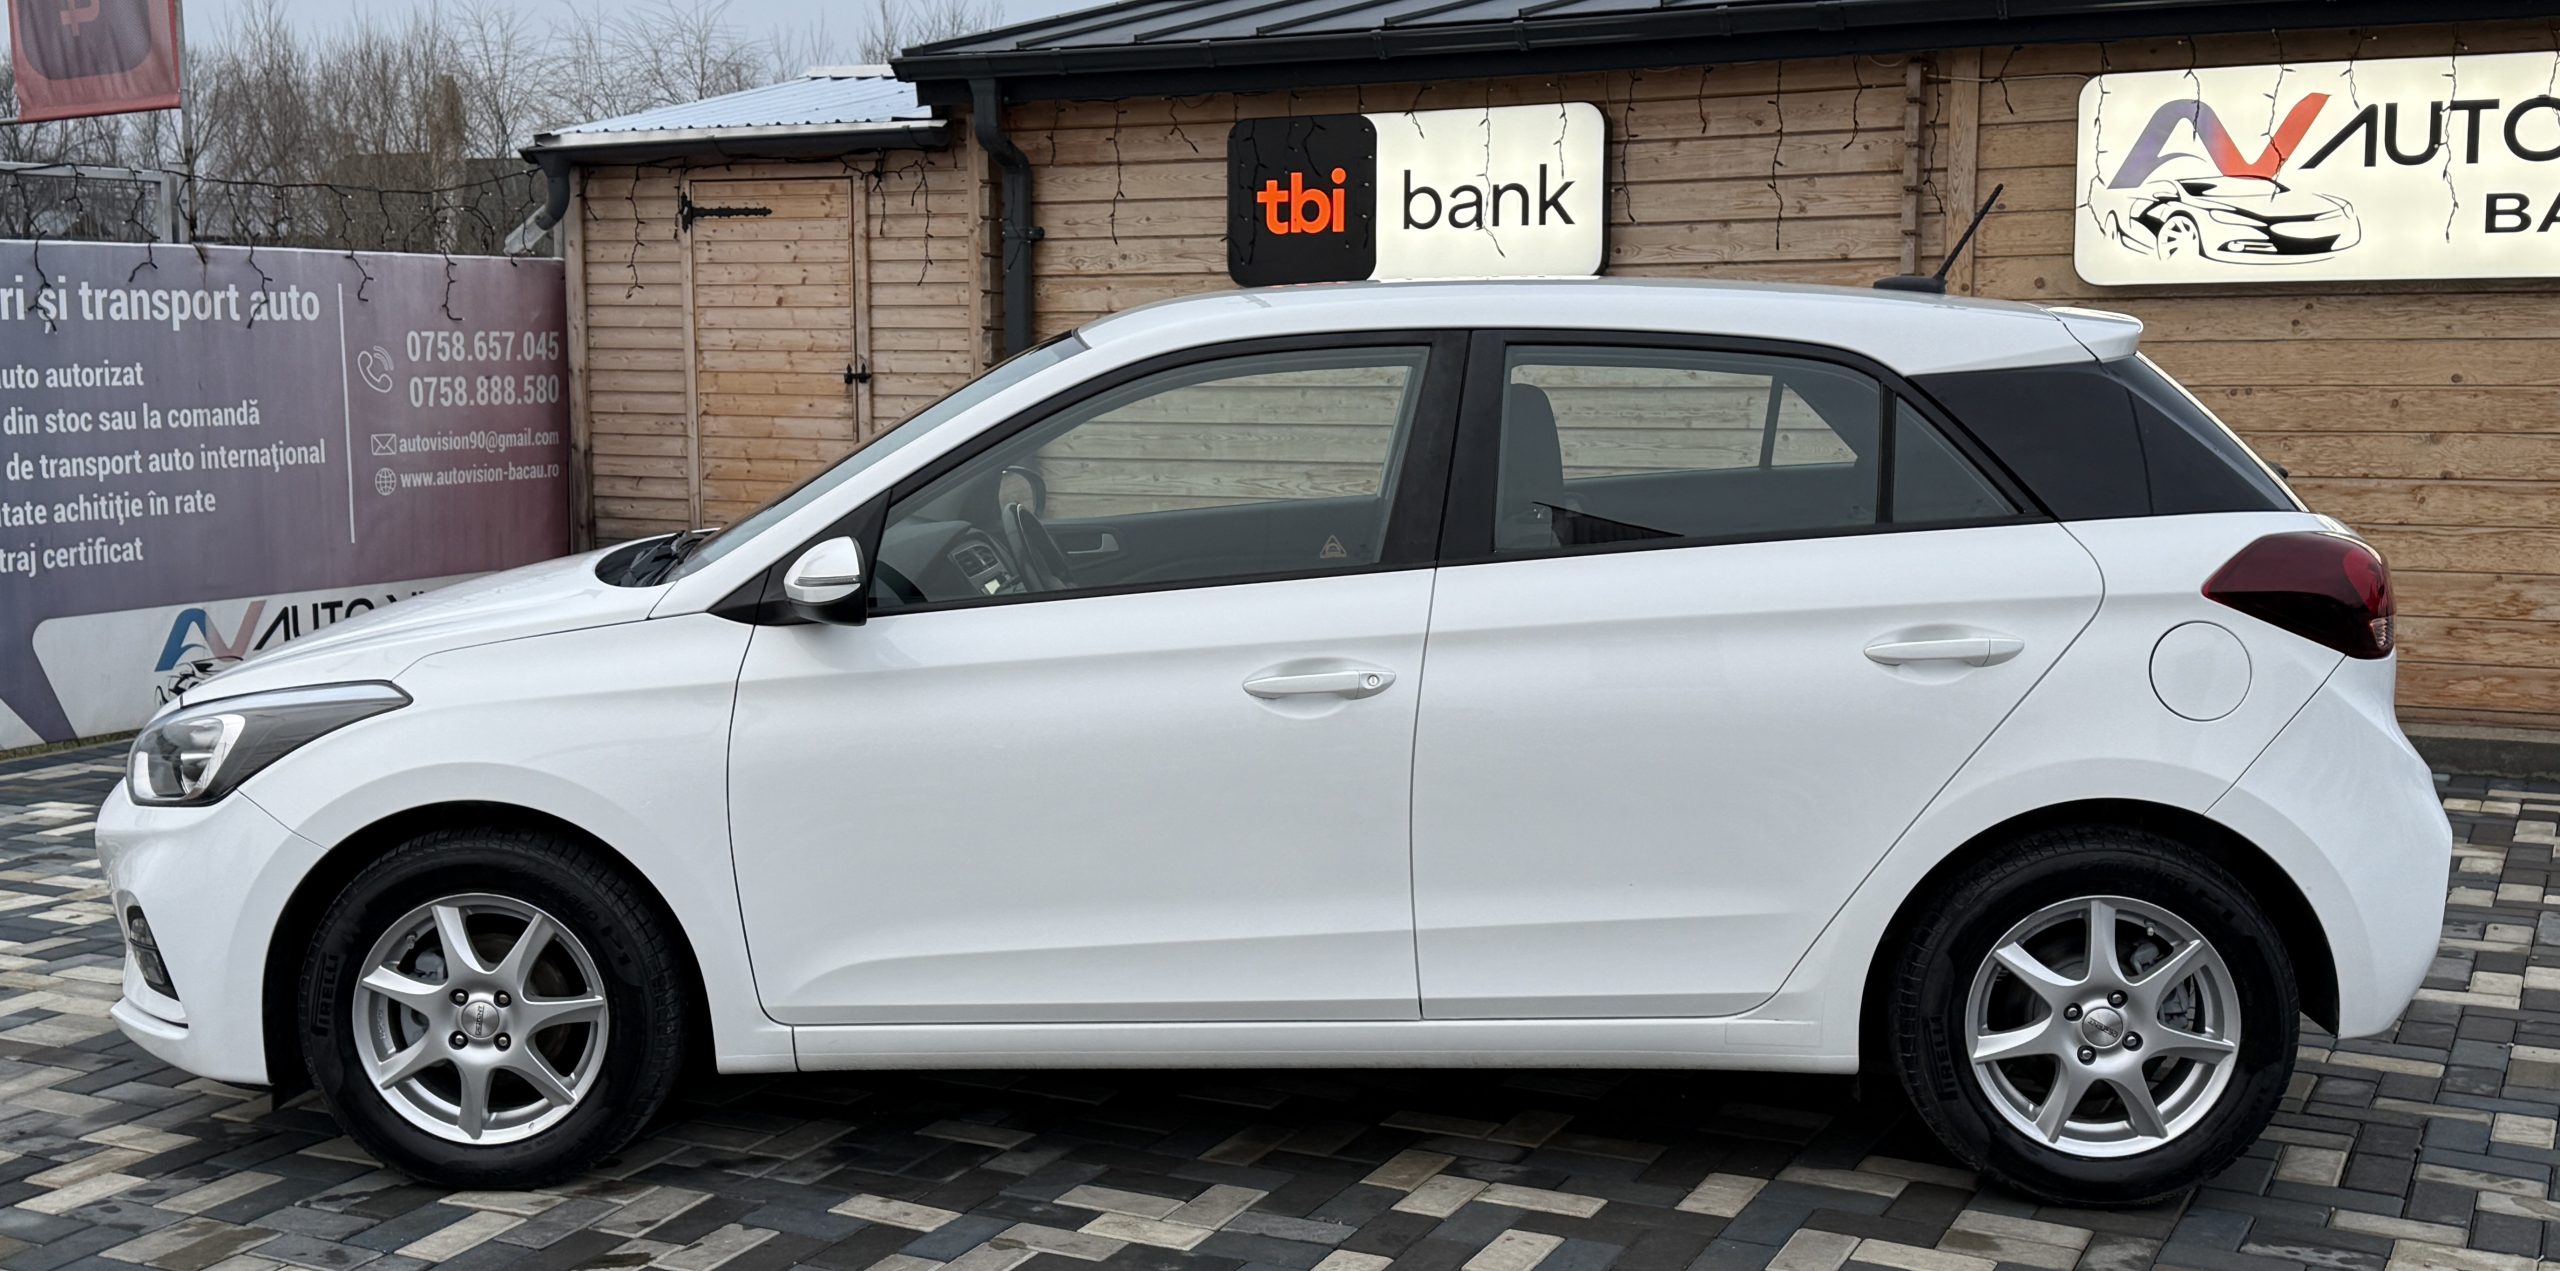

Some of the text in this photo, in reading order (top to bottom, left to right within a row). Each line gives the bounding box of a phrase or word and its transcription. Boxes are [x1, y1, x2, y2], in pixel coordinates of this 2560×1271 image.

[2299, 96, 2560, 169] AUTO
[1256, 163, 1576, 236] tbi bank
[0, 275, 25, 321] ri
[79, 281, 241, 331] transport
[250, 285, 320, 321] auto
[406, 331, 559, 362] 0758.657.045
[0, 359, 144, 389] uto autorizat
[409, 374, 559, 408] 0758.888.580
[3, 399, 260, 435] din stoc sau la comandă
[399, 428, 559, 454] autovision90@gmail.com
[6, 453, 34, 481] de
[39, 450, 142, 482] transport
[149, 448, 194, 472] auto
[400, 462, 559, 488] www.autovision-bacau.ro
[0, 501, 47, 527] tate
[147, 490, 169, 516] în
[175, 489, 216, 514] rate
[43, 537, 144, 570] certificat
[310, 952, 339, 1037] PIRELLI
[1921, 1016, 1959, 1102] PIRELLI
